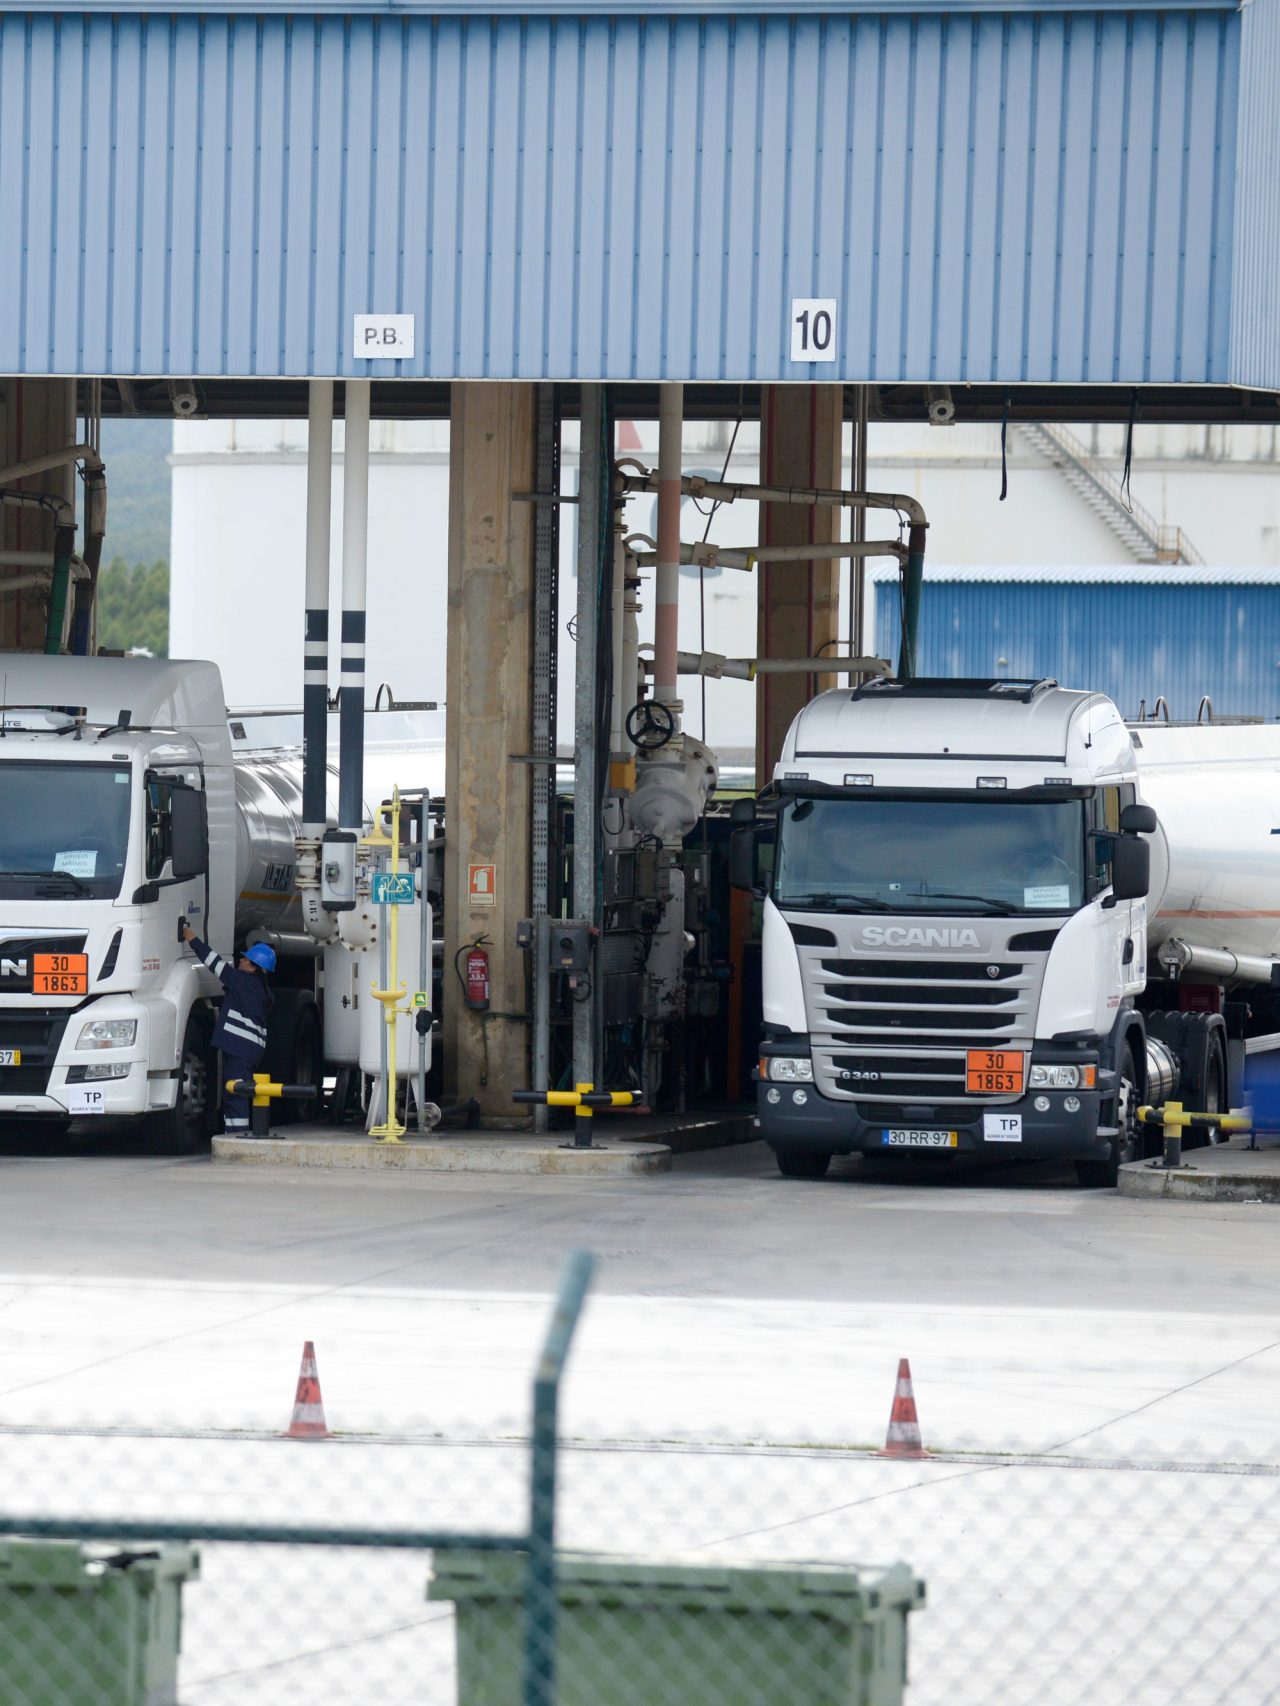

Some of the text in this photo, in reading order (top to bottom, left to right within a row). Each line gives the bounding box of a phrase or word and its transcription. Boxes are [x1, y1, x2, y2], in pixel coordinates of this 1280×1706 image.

[363, 327, 403, 346] P.B.
[794, 310, 832, 350] 10
[862, 927, 981, 948] SCANIA
[51, 956, 69, 972] 30
[42, 976, 78, 992] 1863
[986, 1054, 1004, 1069] 30
[841, 1071, 879, 1080] G 340
[977, 1074, 1014, 1090] 1863
[84, 1092, 102, 1103] TP
[1000, 1119, 1018, 1131] TP
